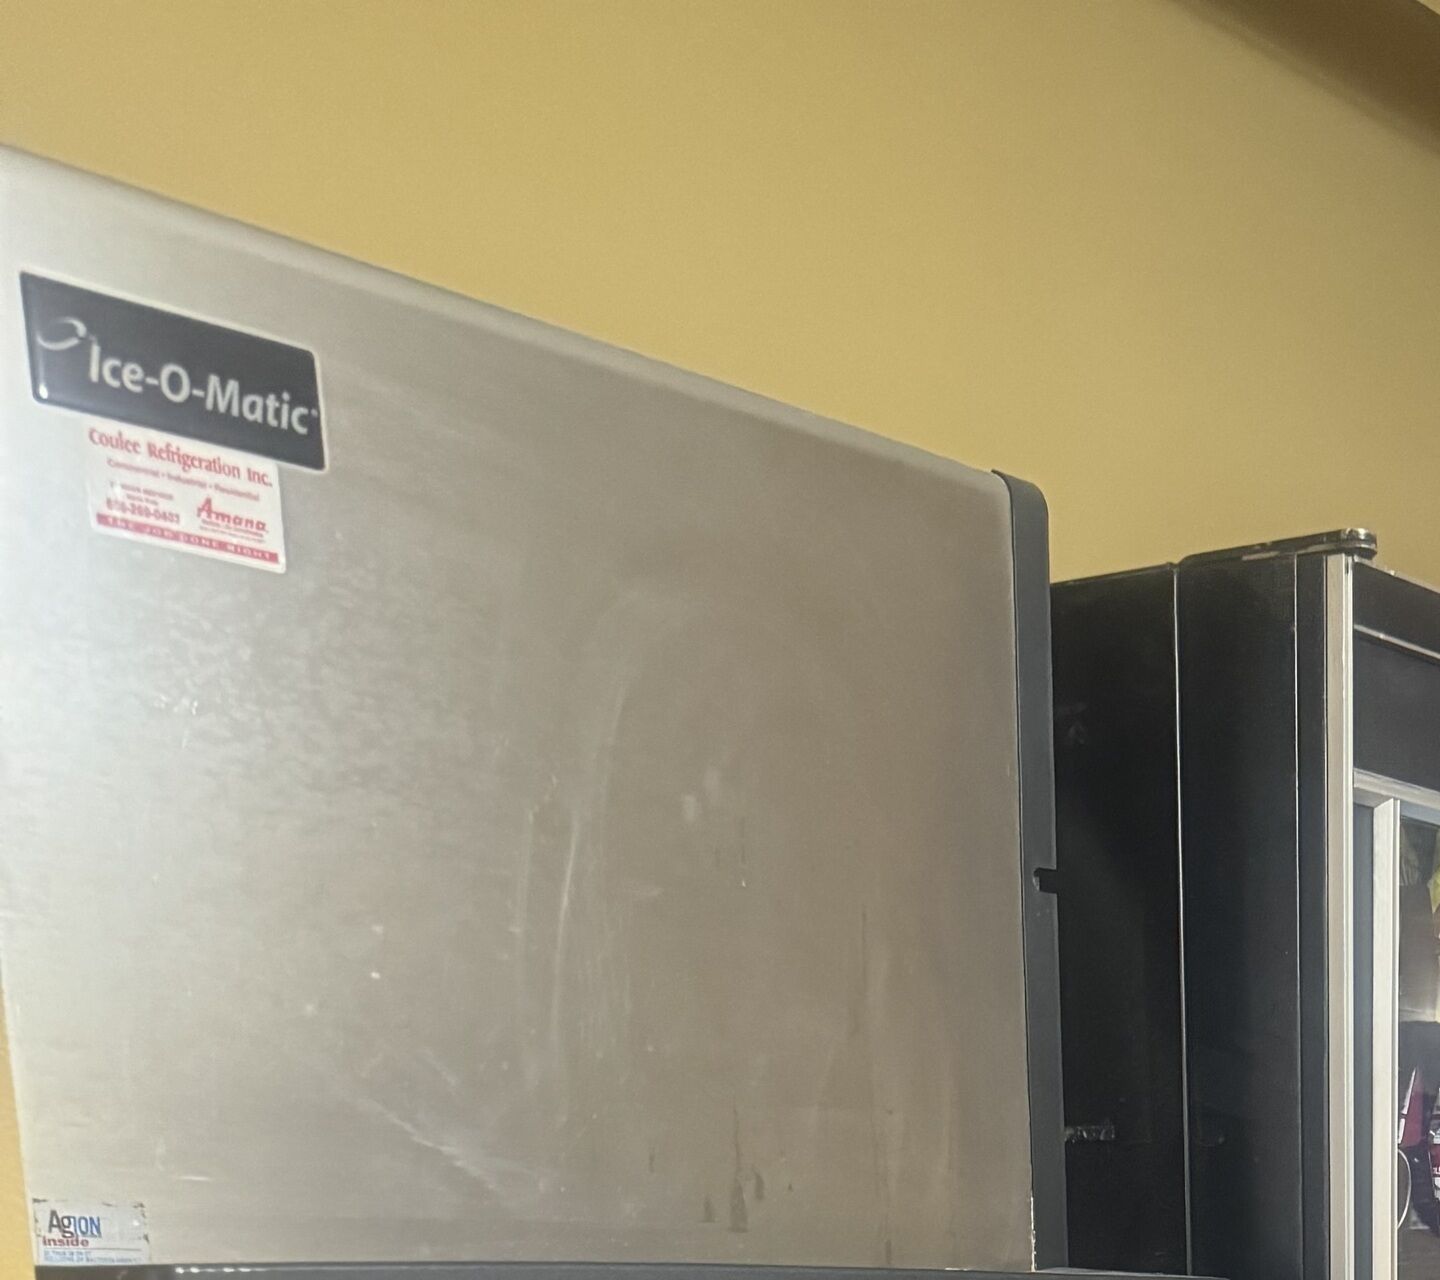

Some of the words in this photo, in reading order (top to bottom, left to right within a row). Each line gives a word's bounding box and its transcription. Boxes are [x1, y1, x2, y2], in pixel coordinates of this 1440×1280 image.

[89, 338, 310, 434] Ice-O-Matic
[88, 427, 141, 454] Coulee
[147, 441, 241, 473] Refrigeration
[246, 467, 273, 487] Inc.
[196, 497, 268, 532] Amana
